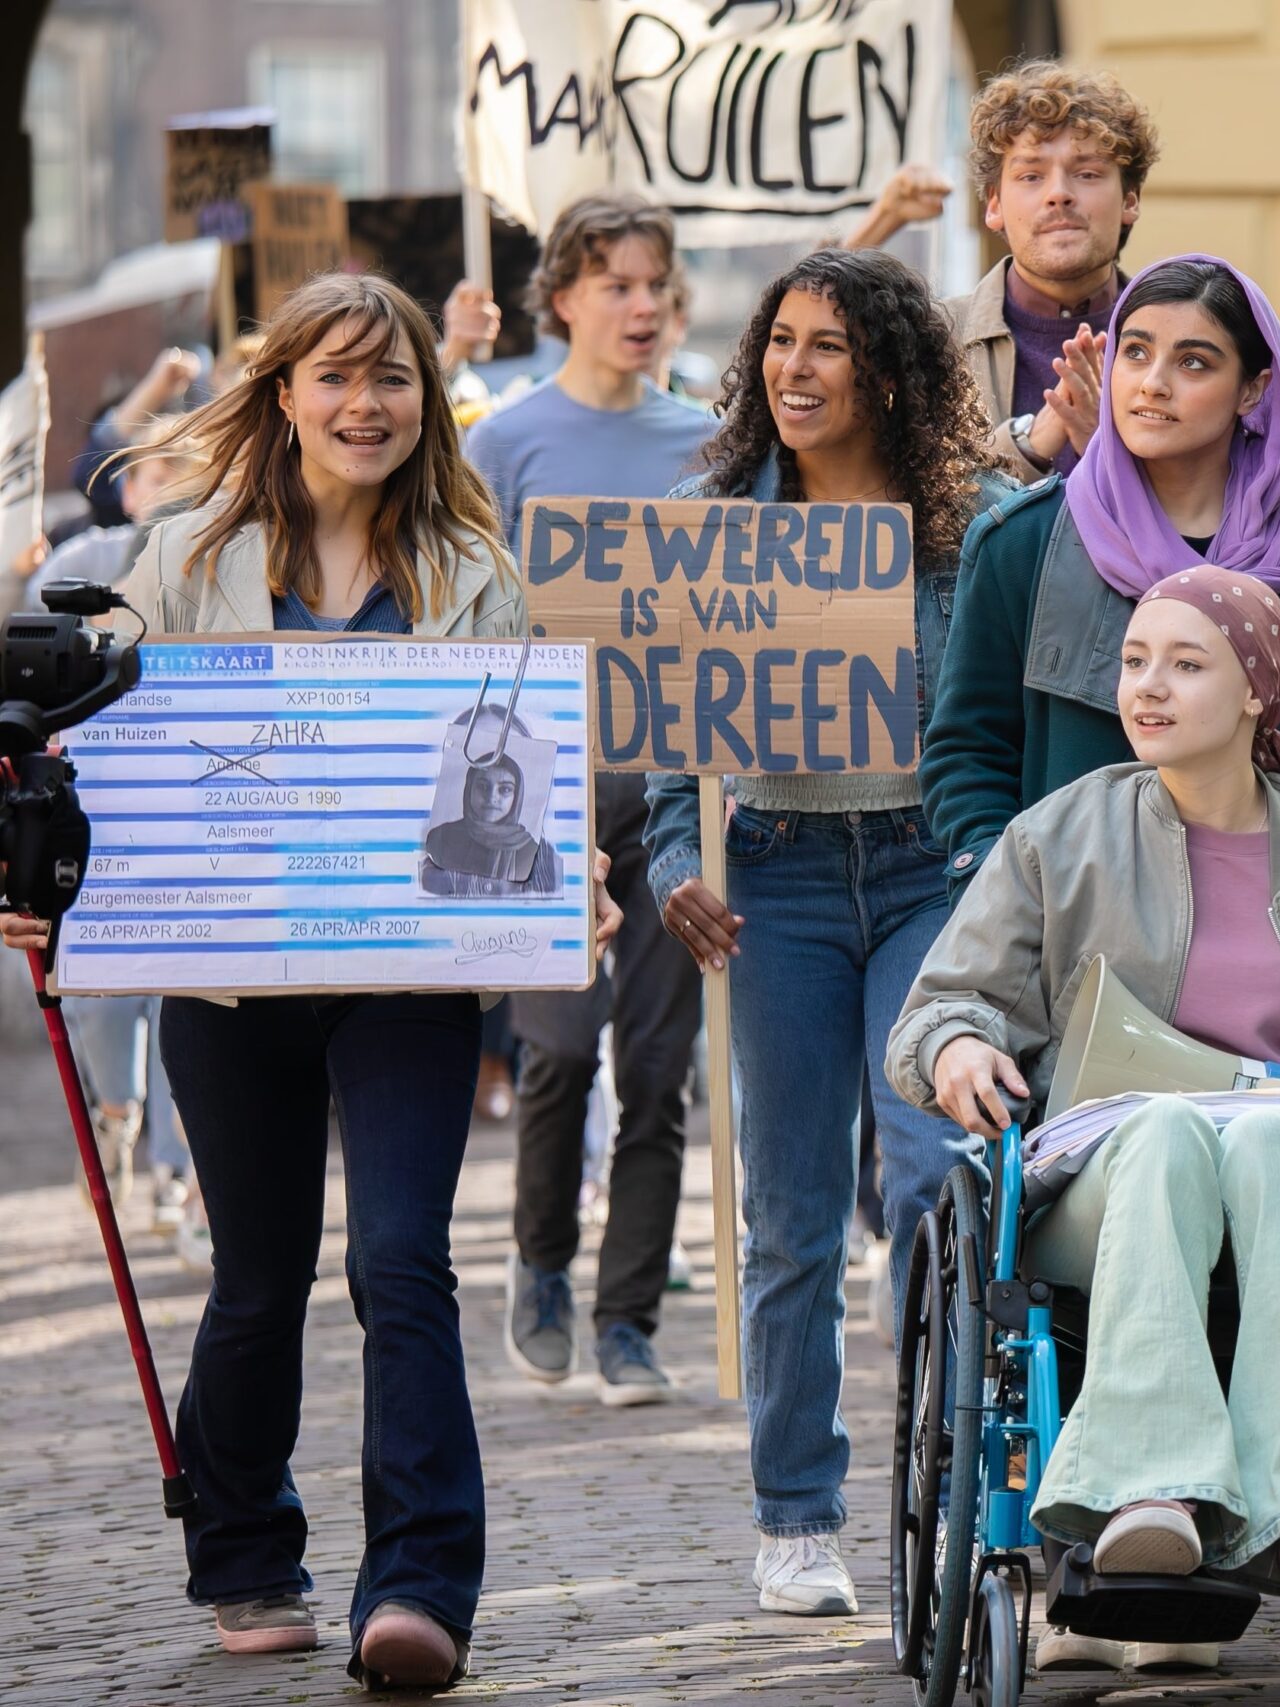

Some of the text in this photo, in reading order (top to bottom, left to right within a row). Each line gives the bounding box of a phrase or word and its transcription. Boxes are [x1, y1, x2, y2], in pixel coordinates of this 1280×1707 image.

[612, 13, 914, 192] RUILEN
[528, 502, 630, 586] DE
[620, 587, 777, 638] IS VAN
[284, 646, 584, 660] KONINKRIJK DER NEDERLNDEN
[145, 656, 267, 669] TEITSKAART
[112, 692, 172, 706] erlandse
[286, 691, 370, 705] XXP100154
[597, 645, 919, 772] DEREEN
[83, 727, 167, 741] van Huizen
[250, 720, 325, 746] ZAHRA
[205, 791, 342, 805] 22 AUG/AUG 1990
[207, 825, 275, 838] Aalsmeer
[90, 858, 129, 872] .67 m
[209, 857, 220, 871] V
[287, 855, 366, 870] 222267421
[80, 890, 252, 908] Burgemeester Aalsmeer
[80, 923, 212, 939] 26 APR/APR 2002
[290, 920, 420, 936] 26 APR/APR 2007
